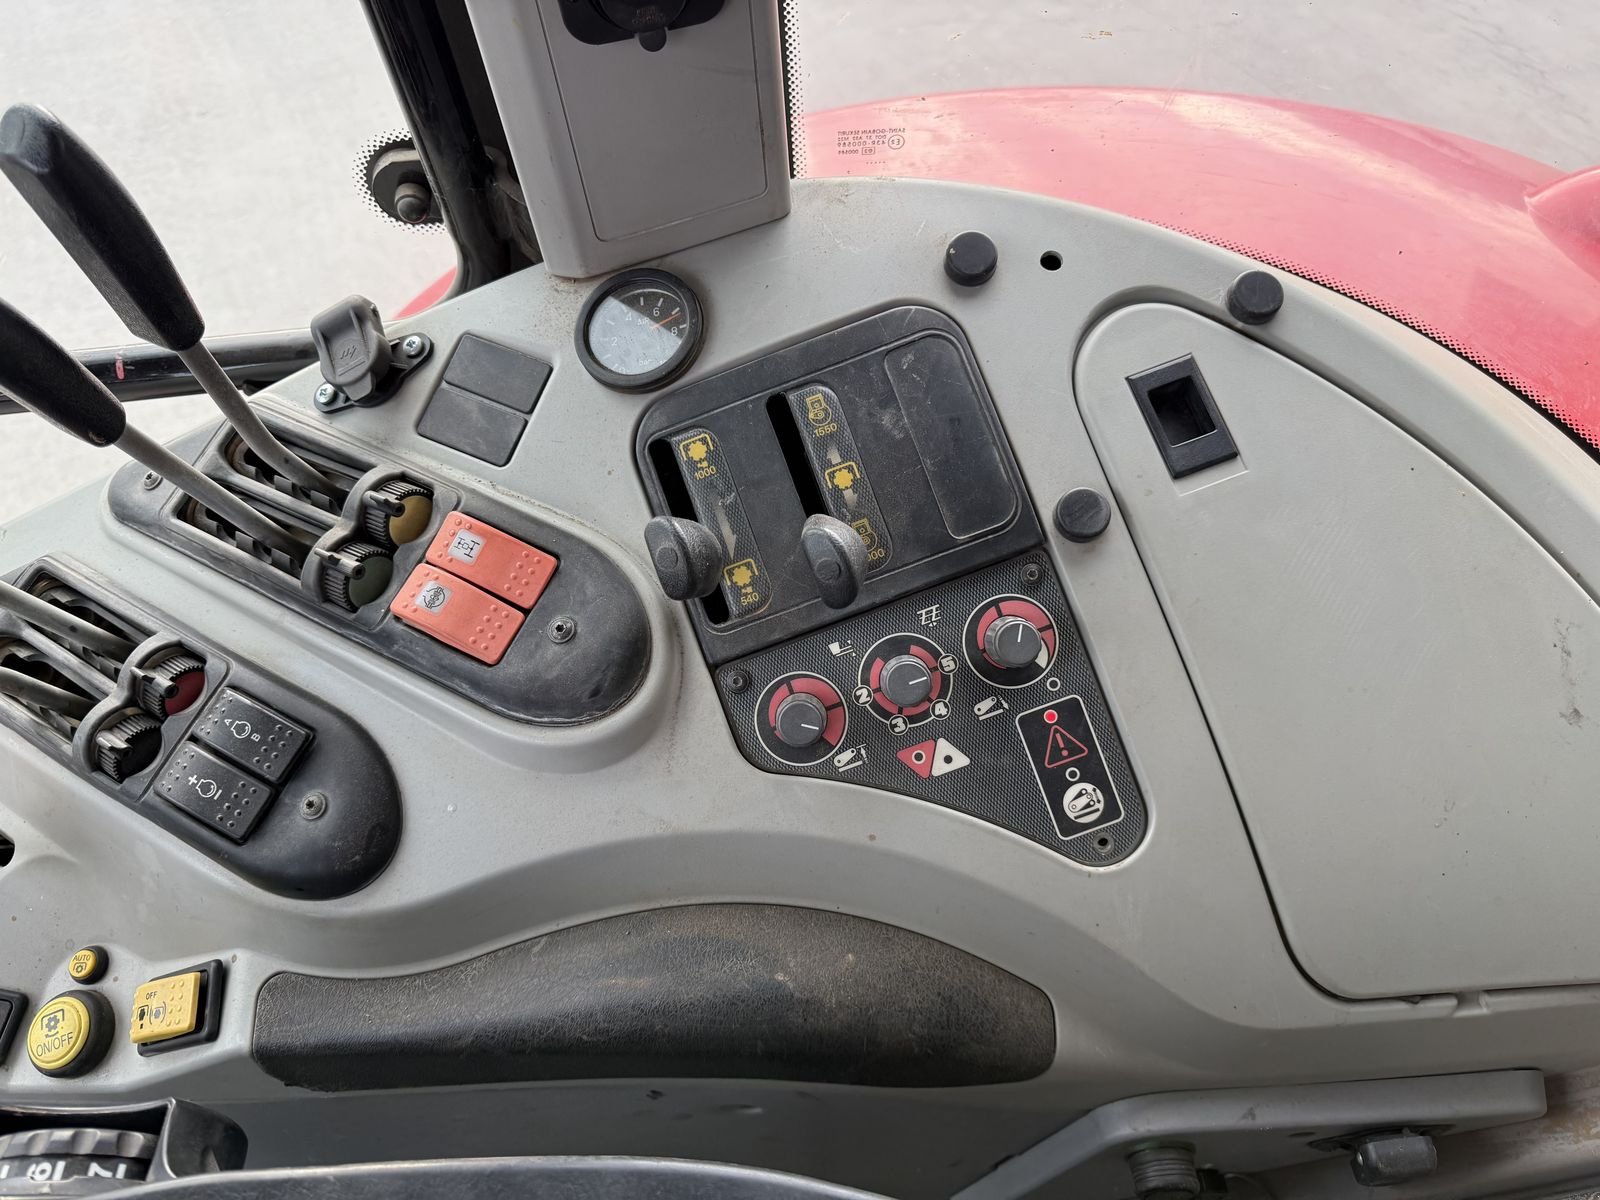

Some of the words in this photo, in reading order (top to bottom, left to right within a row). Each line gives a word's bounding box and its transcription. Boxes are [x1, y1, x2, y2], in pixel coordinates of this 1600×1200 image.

[653, 307, 660, 316] 6
[671, 326, 678, 336] 8
[610, 336, 618, 346] 2
[813, 422, 838, 438] 1550
[693, 465, 717, 481] 1000
[740, 592, 760, 606] 540
[940, 656, 956, 672] 5
[855, 687, 871, 703] 2
[934, 701, 948, 716] 4
[223, 717, 233, 727] A
[891, 717, 906, 733] 3
[251, 732, 261, 742] B
[72, 953, 91, 963] AUTO
[145, 990, 159, 1000] OFF
[35, 1032, 74, 1058] ON/OFF
